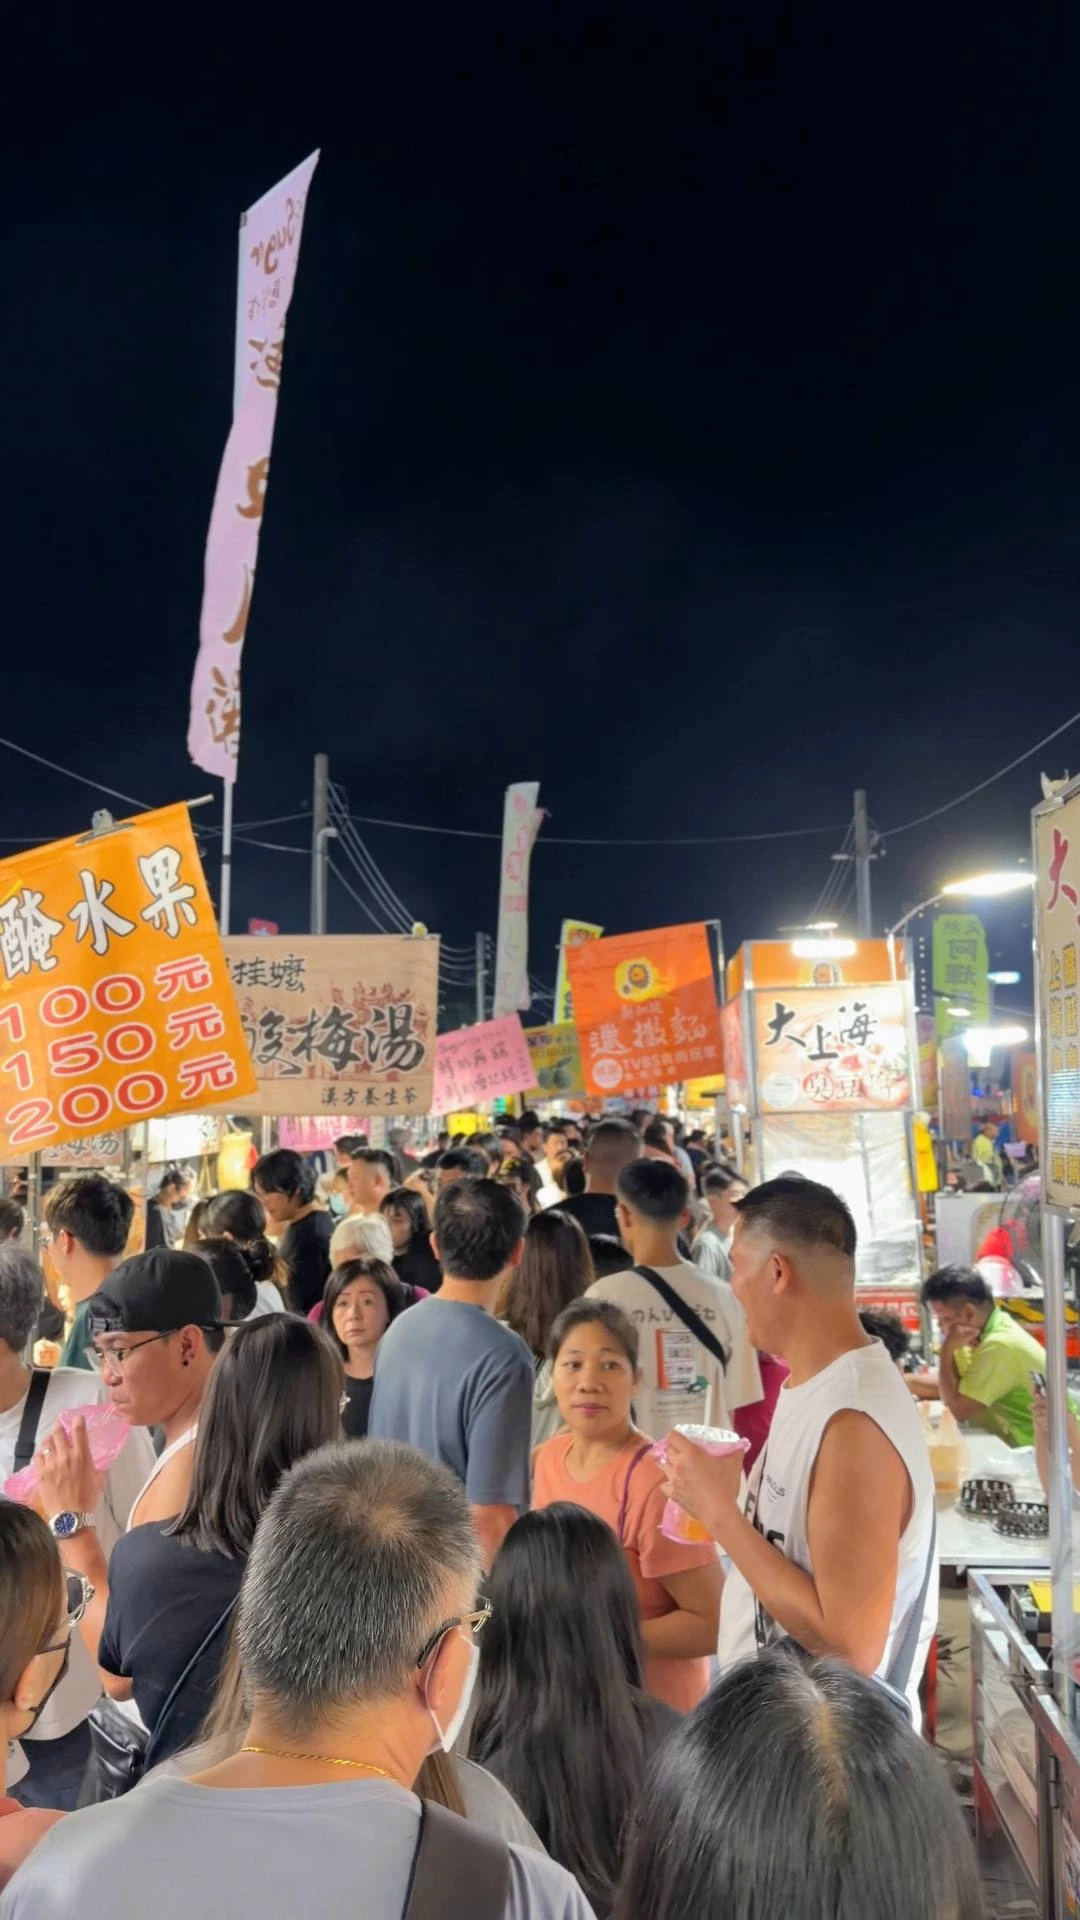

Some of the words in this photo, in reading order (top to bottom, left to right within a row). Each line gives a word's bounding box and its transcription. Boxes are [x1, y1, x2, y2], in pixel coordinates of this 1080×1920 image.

[0, 845, 198, 980] 醃水果
[1, 1002, 225, 1091] 150元
[764, 1002, 878, 1061] 大上海
[5, 1051, 237, 1145] 200元
